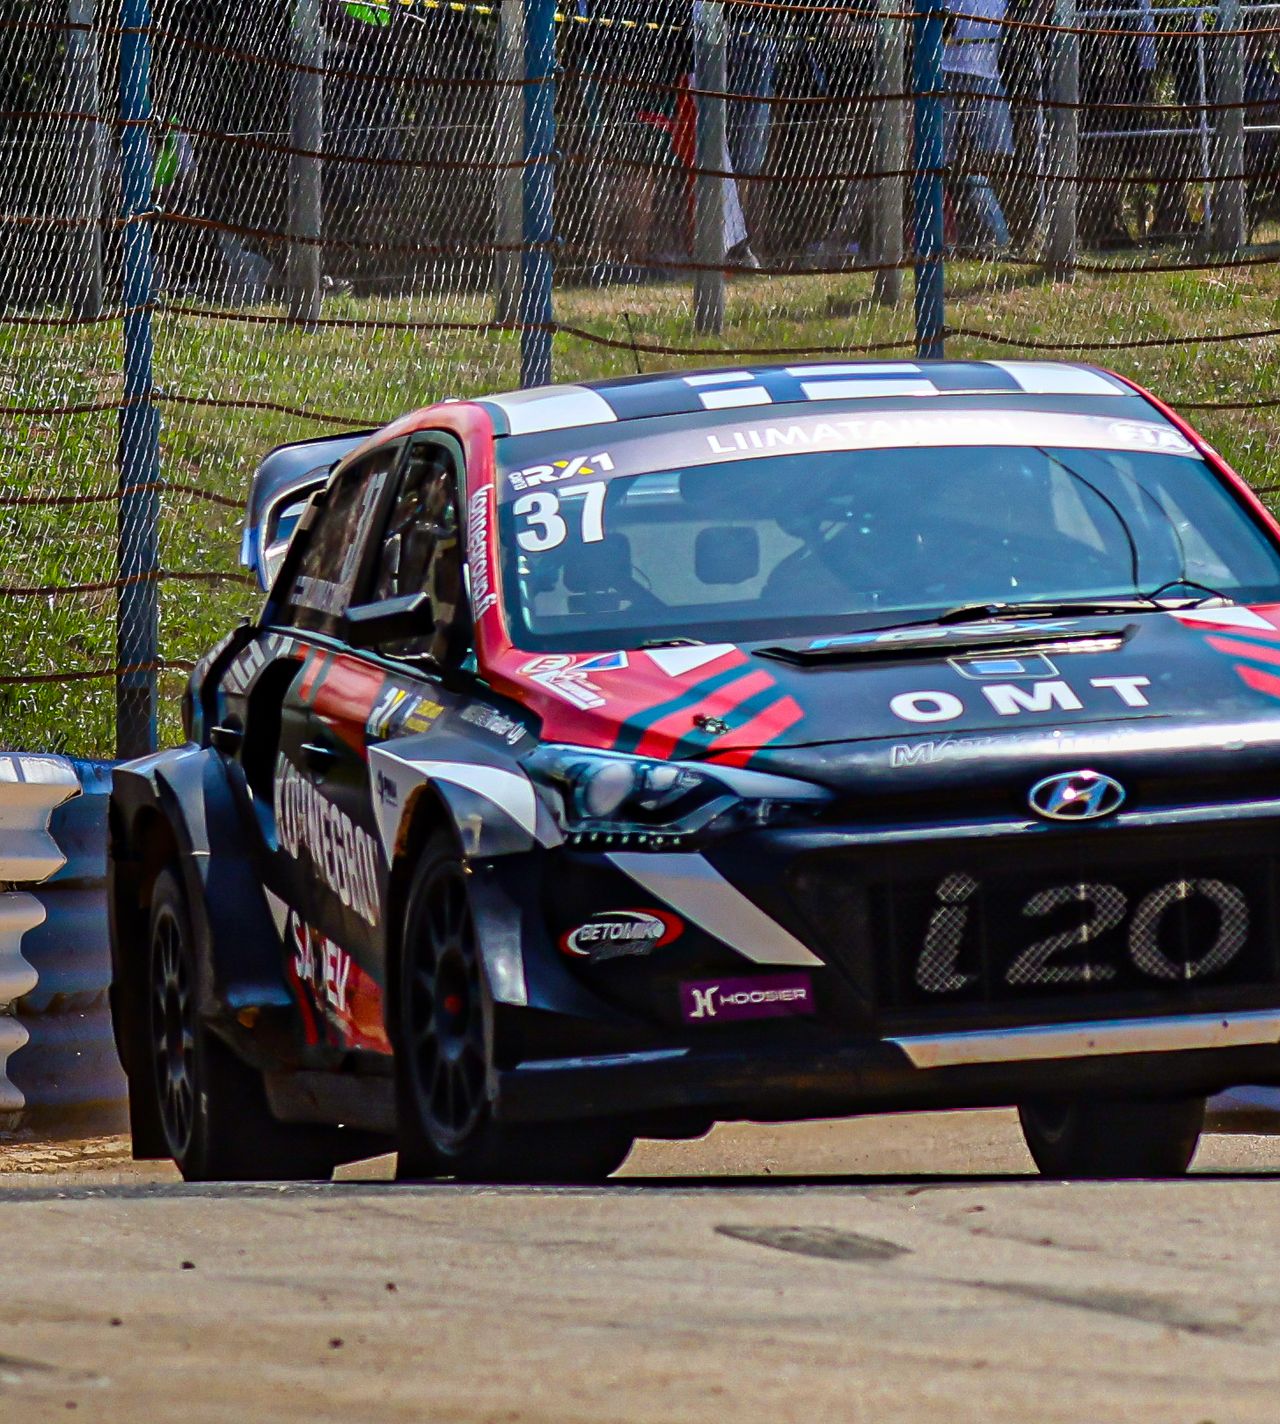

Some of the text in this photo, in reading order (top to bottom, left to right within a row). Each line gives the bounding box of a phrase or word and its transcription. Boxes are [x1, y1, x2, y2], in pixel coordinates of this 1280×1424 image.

[521, 452, 615, 487] RX1
[513, 481, 608, 551] 37
[889, 676, 1151, 722] OMT
[914, 872, 1251, 993] i20
[719, 988, 807, 1006] HOOSIER
